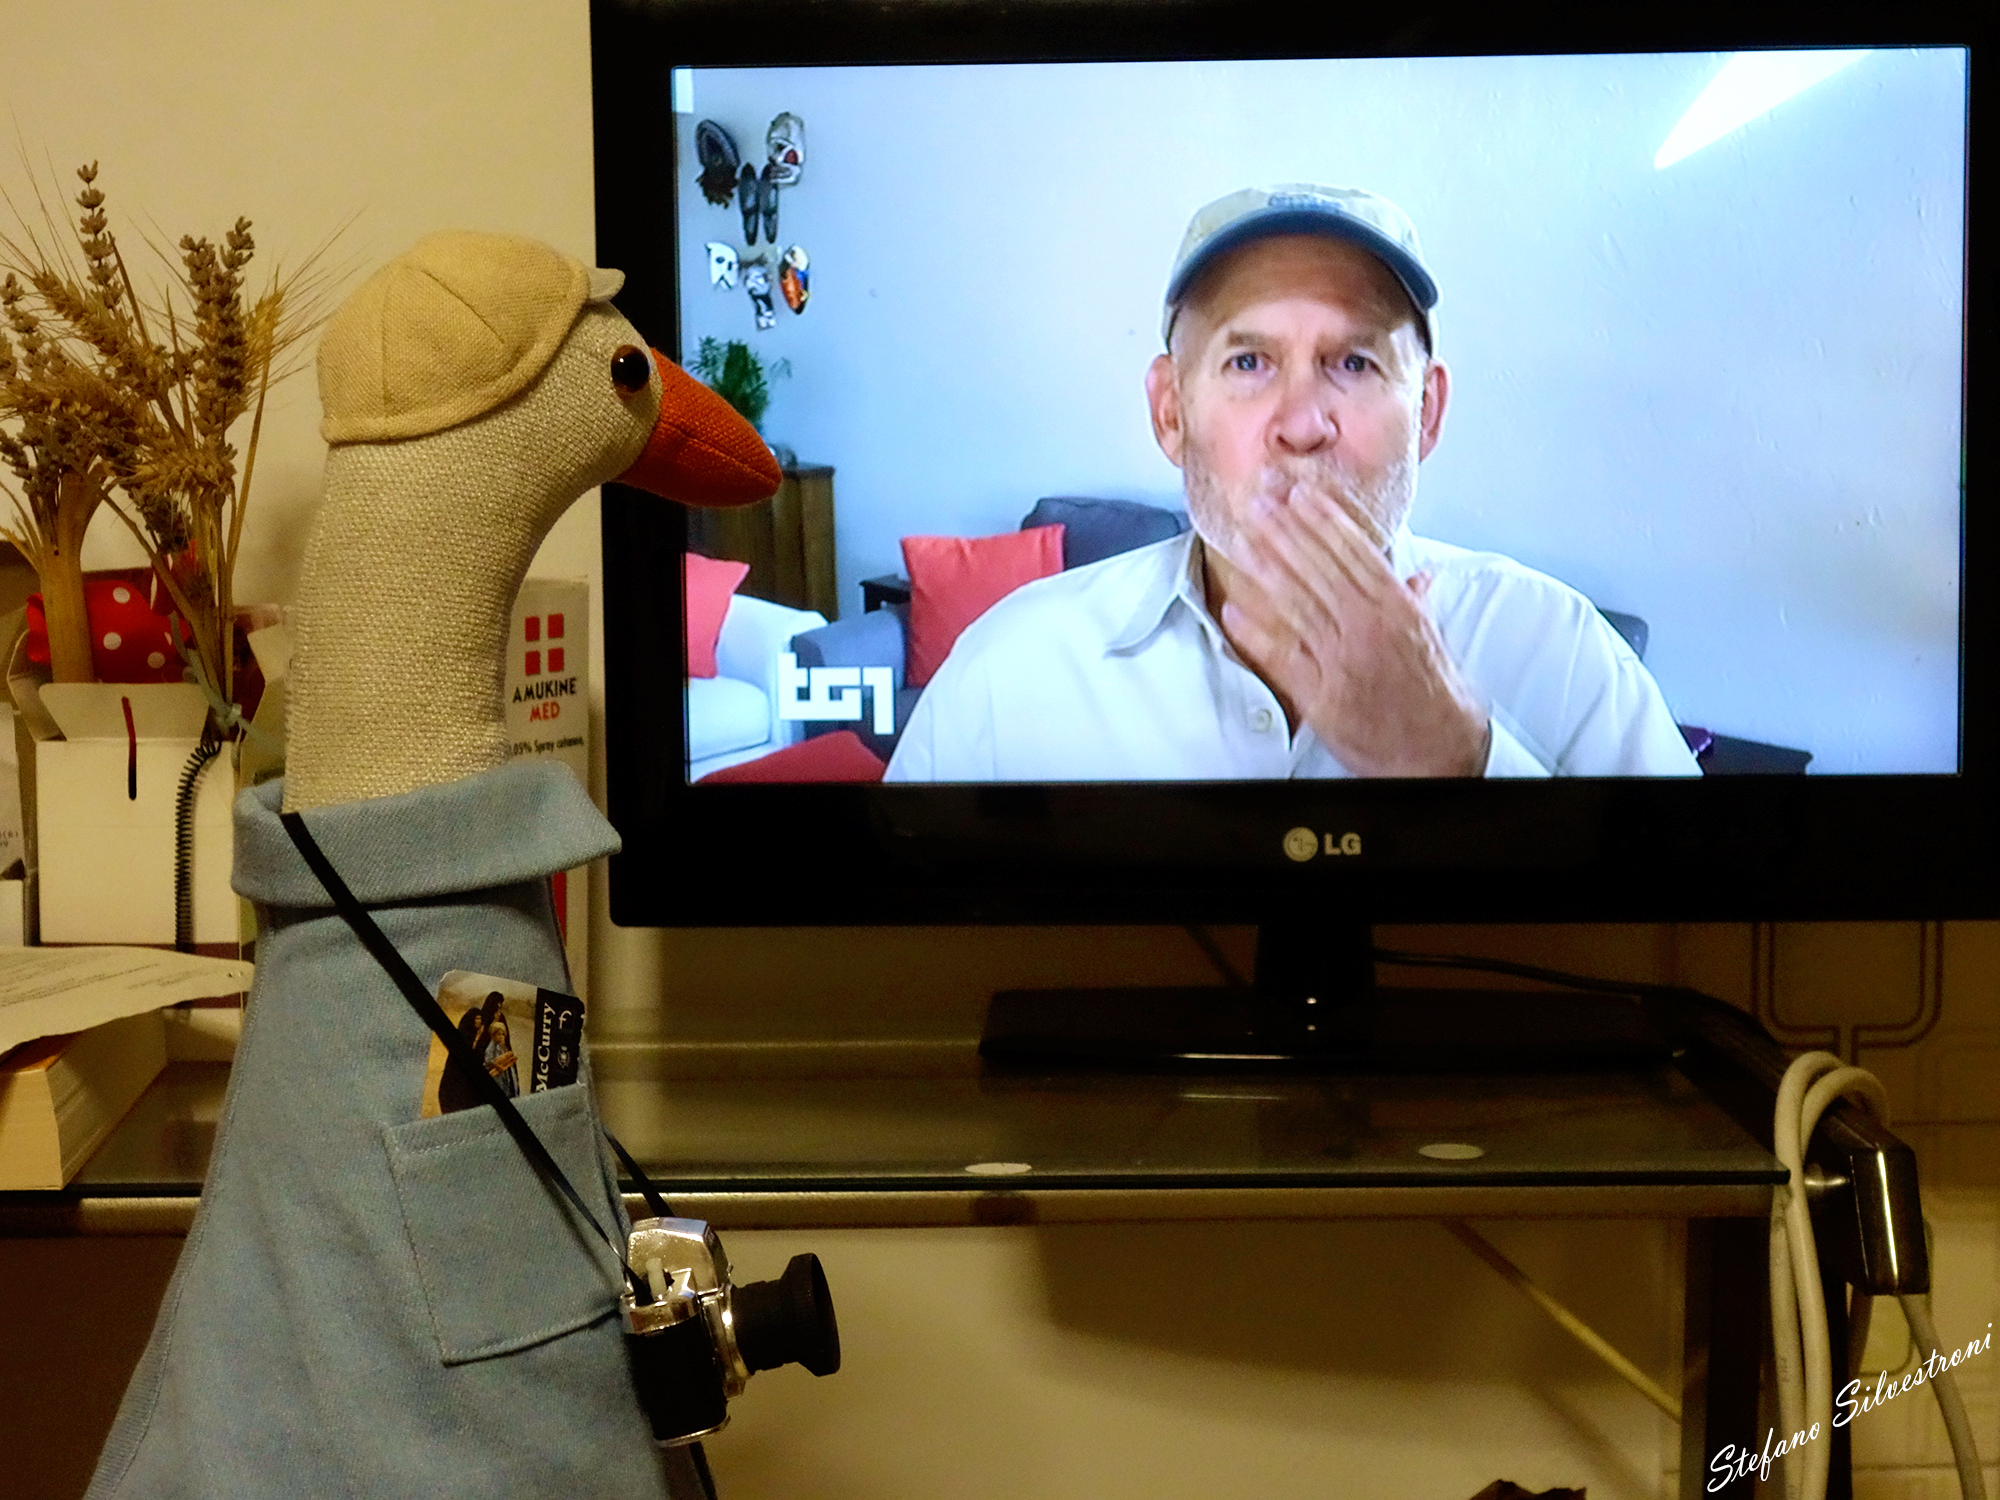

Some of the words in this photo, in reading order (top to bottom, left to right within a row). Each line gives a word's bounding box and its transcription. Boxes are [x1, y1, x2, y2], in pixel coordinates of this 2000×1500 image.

[512, 677, 577, 703] AMUKINE
[529, 701, 561, 722] MED
[1324, 832, 1362, 856] LG
[535, 1002, 556, 1091] McCurry
